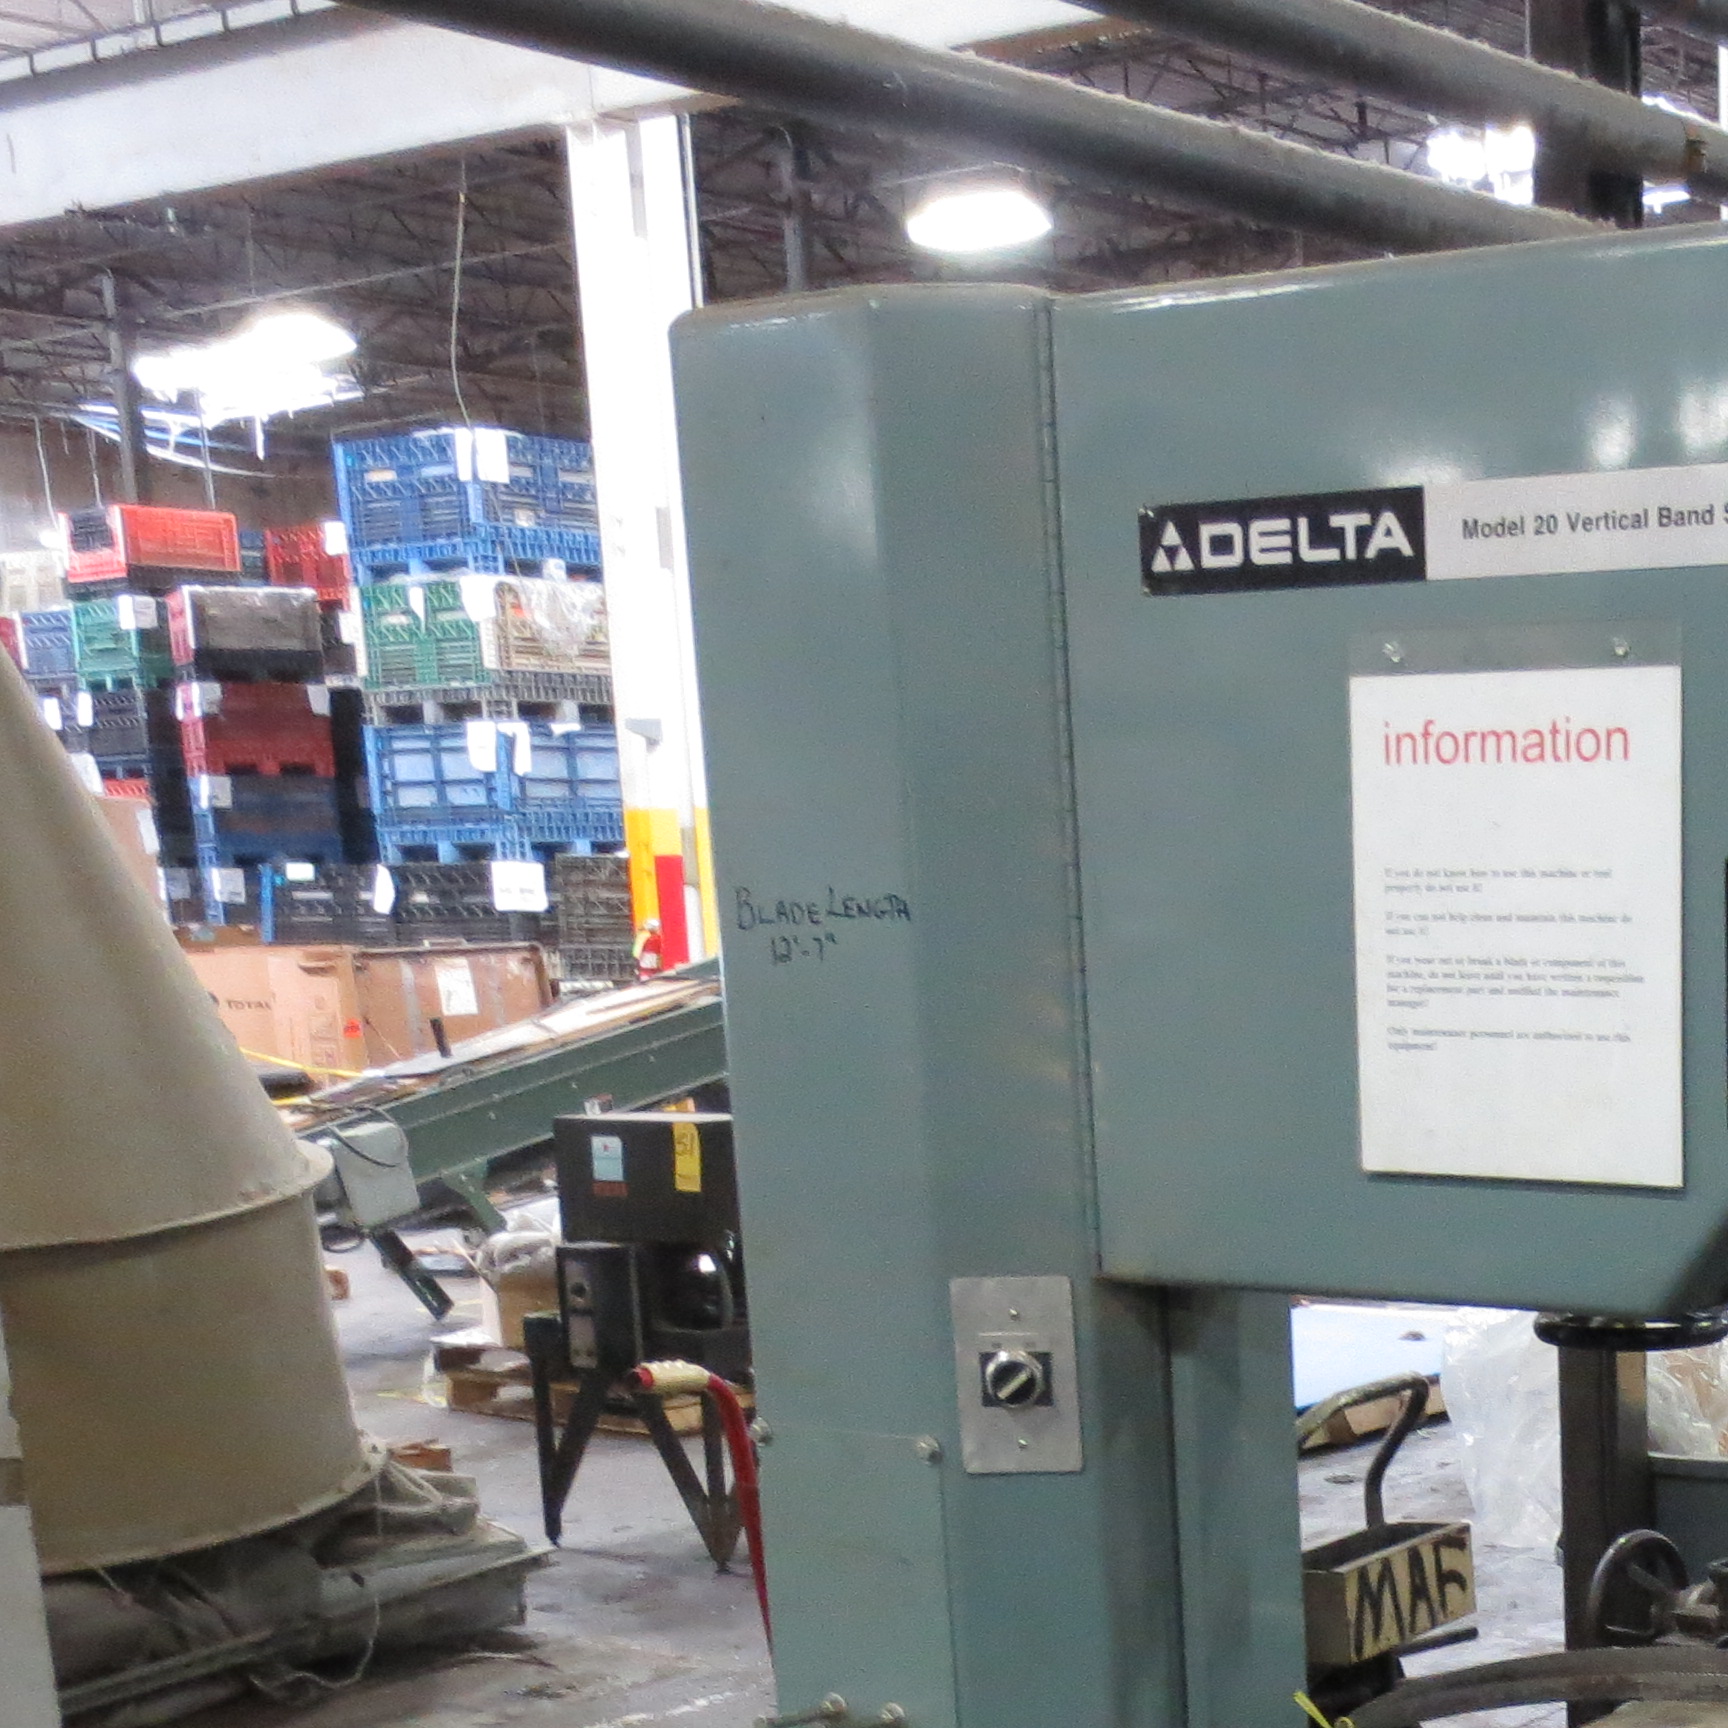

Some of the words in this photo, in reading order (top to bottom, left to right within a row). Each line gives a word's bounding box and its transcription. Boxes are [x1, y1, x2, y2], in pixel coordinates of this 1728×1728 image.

[1199, 511, 1414, 569] DELTA
[1462, 515, 1525, 539] Model
[1533, 513, 1558, 535] 20
[1566, 508, 1649, 533] Vertical
[1657, 504, 1715, 527] Band
[1383, 716, 1631, 766] information
[735, 886, 823, 931] BLADE
